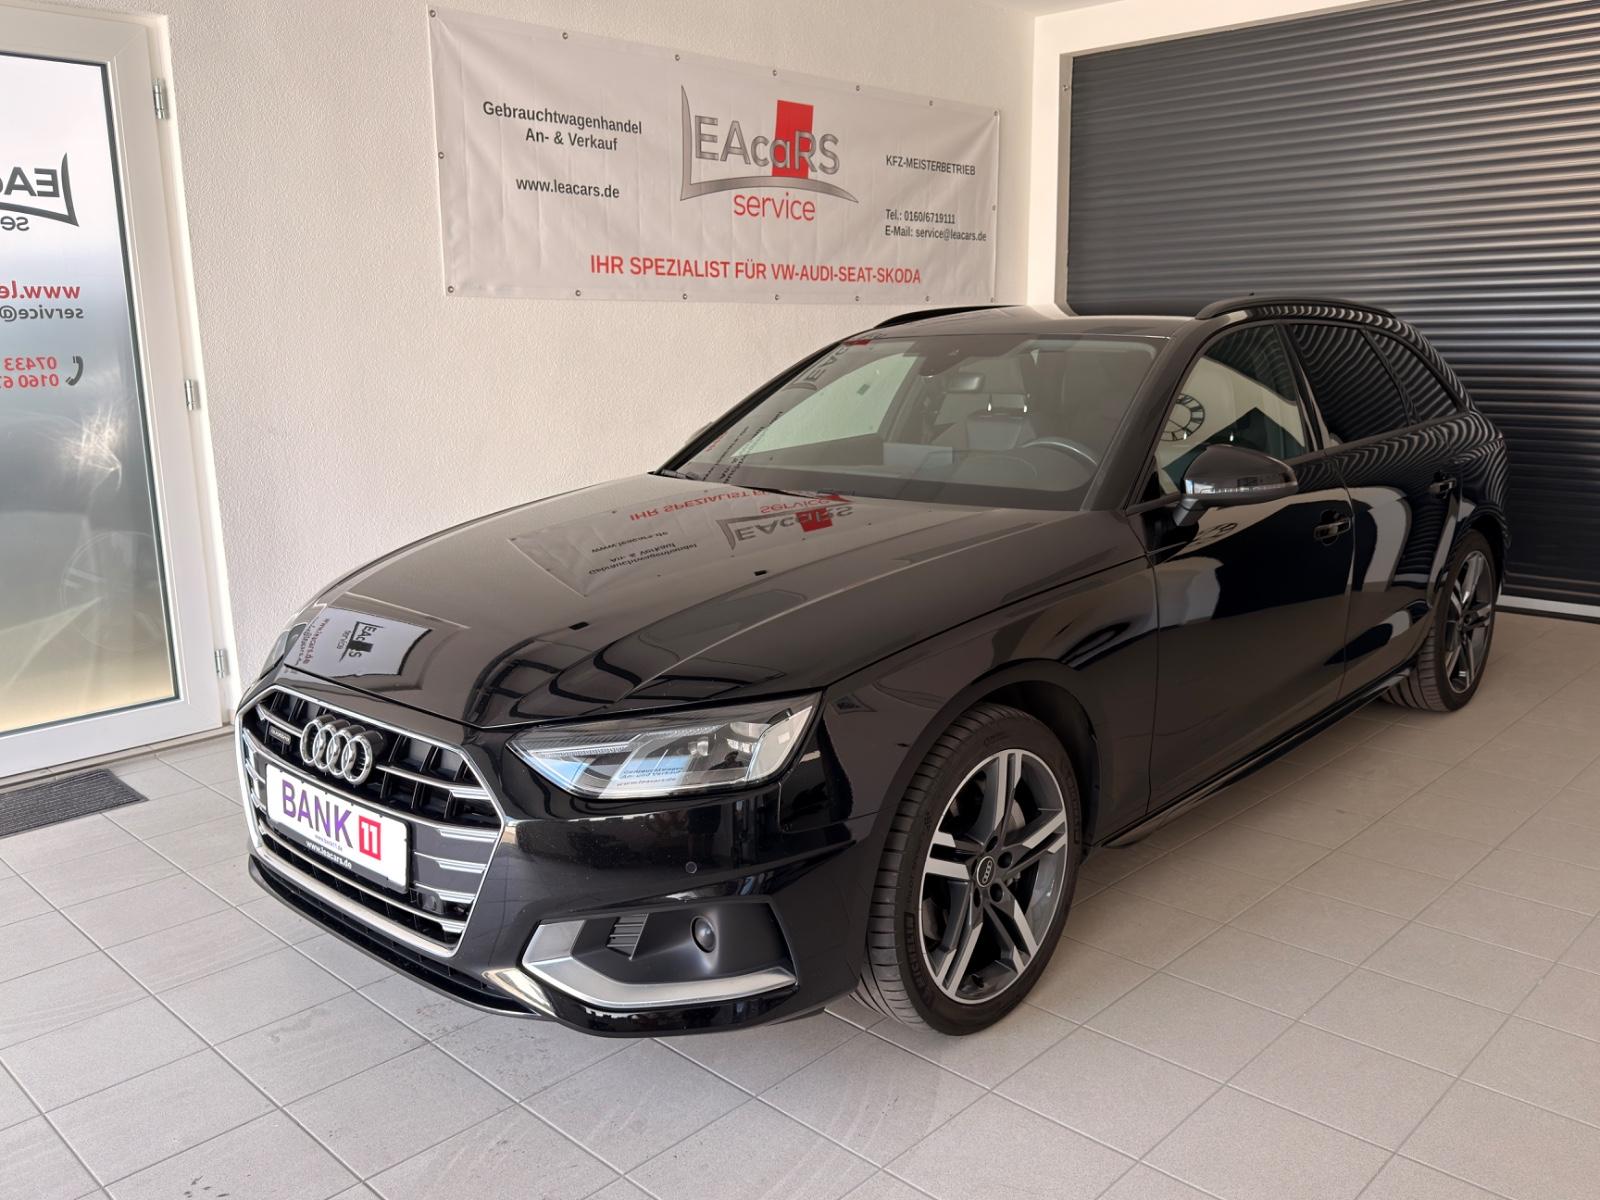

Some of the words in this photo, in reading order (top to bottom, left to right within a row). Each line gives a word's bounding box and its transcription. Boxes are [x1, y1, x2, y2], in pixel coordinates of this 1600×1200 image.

[483, 101, 642, 134] Gebrauchtwagenhandel
[525, 128, 549, 143] An-
[553, 131, 564, 145] &
[568, 132, 618, 150] Verkauf
[886, 154, 976, 176] KFZ-MEISTERBETRIEB
[516, 178, 620, 198] www.leacars.de
[733, 192, 816, 221] service
[885, 208, 902, 221] Tel.:
[904, 210, 956, 224] 0160/6719111
[885, 225, 913, 238] E-Mail:
[915, 228, 987, 242] service@leacars.de
[590, 255, 624, 274] IHR
[629, 257, 730, 279] SPEZIALIST
[735, 259, 767, 280] FÜR
[771, 263, 921, 284] VW-AUDI-SEAT-SKODA
[282, 779, 353, 848] BANK
[360, 819, 379, 857] 11
